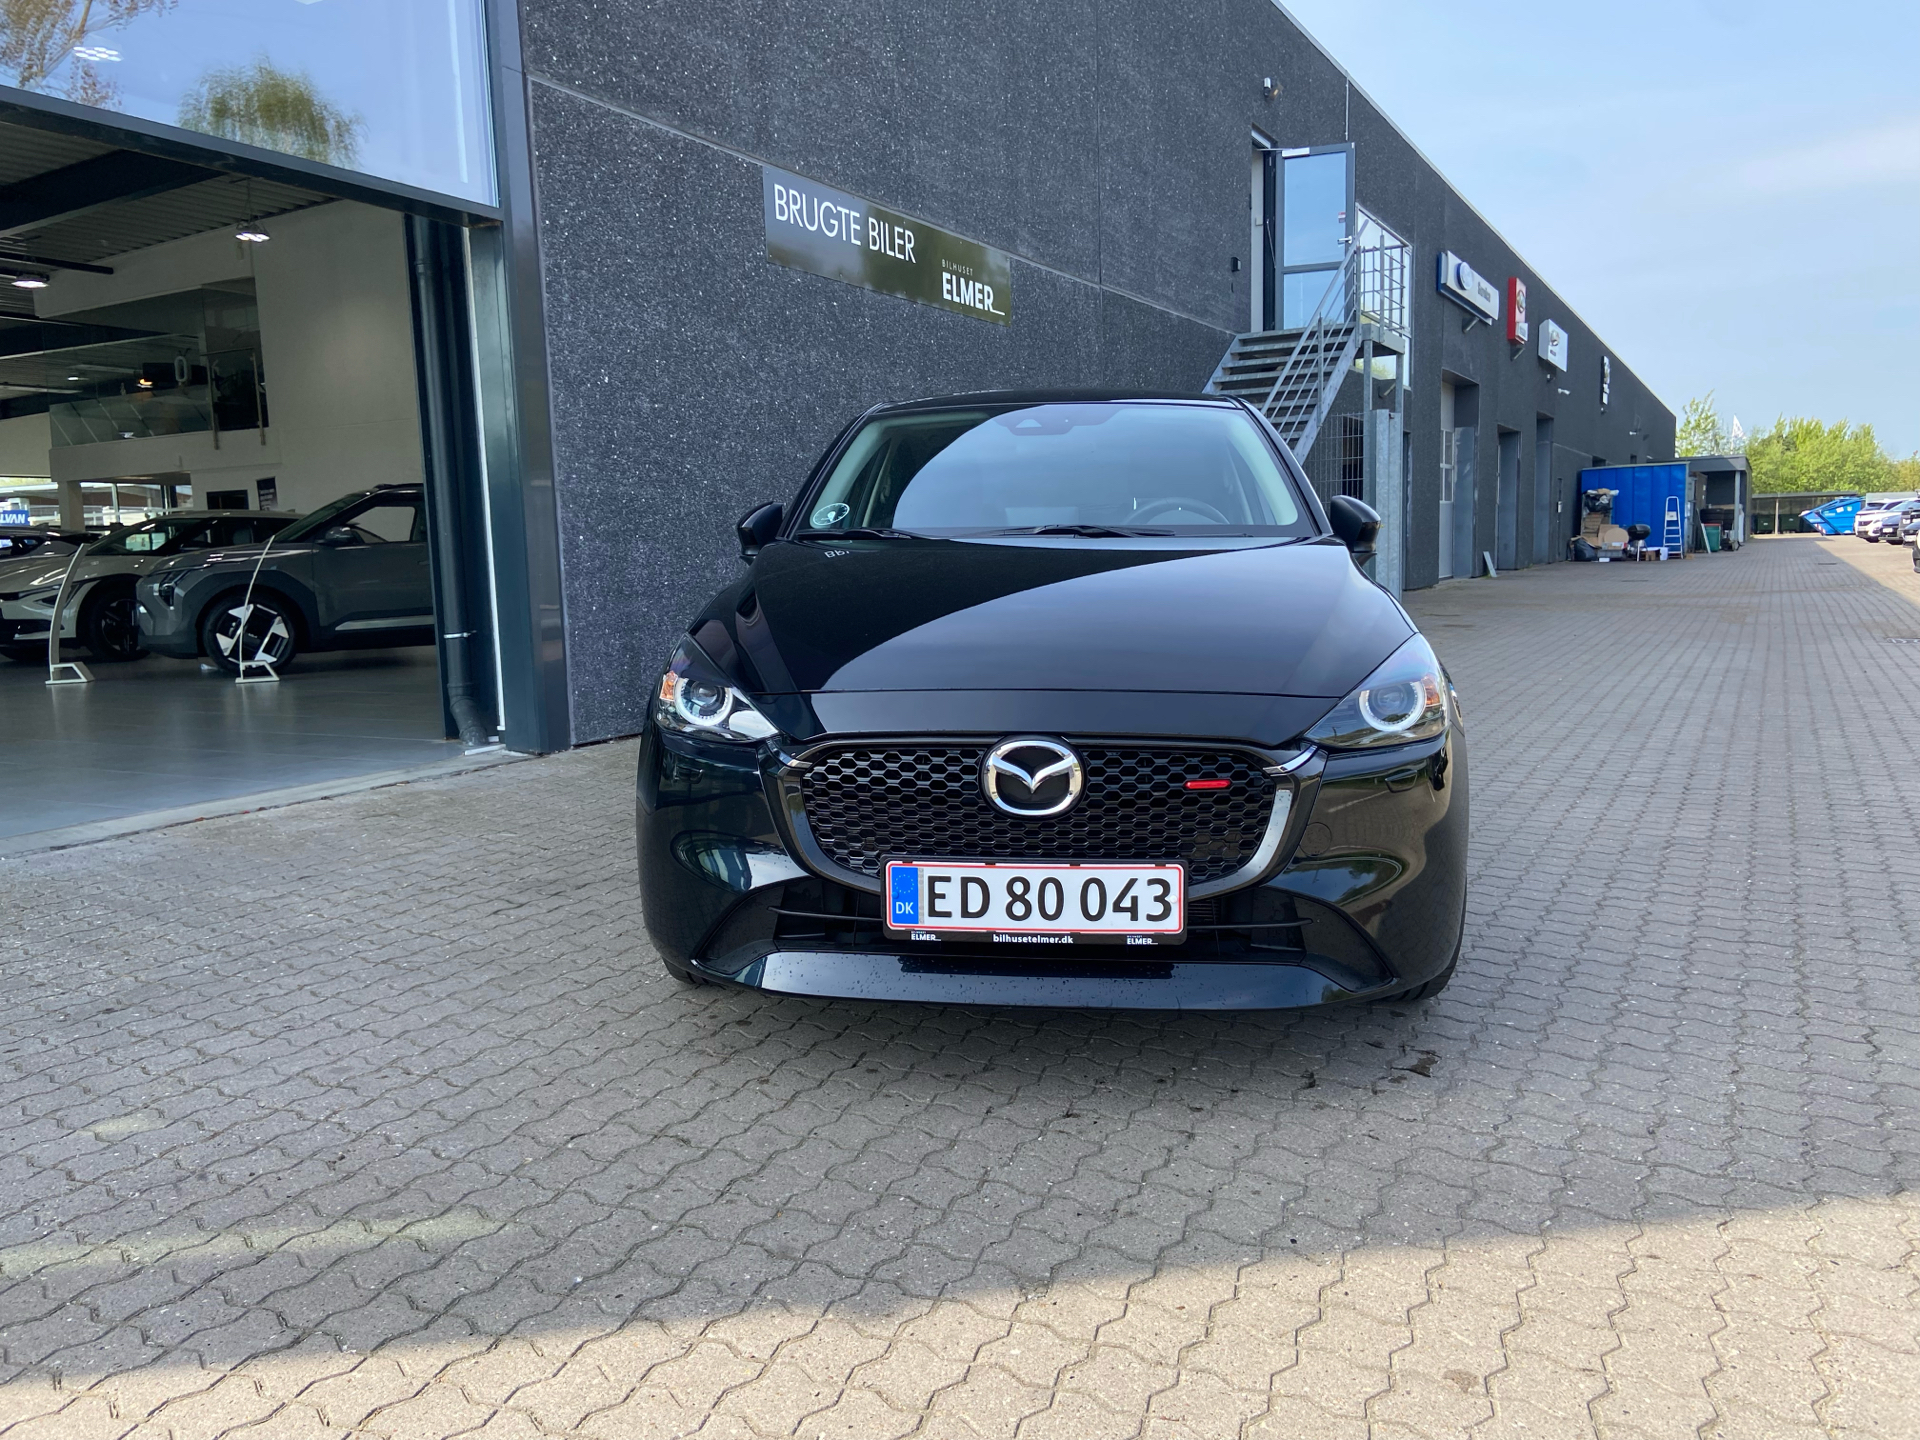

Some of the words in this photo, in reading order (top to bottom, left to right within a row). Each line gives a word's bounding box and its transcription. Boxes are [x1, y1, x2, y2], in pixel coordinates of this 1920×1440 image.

[774, 183, 862, 246] BRUGTE
[868, 216, 917, 264] BILER
[941, 258, 974, 276] BILHUSET
[927, 875, 991, 918] ED
[1005, 876, 1065, 922] 80
[1080, 877, 1172, 922] 043
[895, 901, 914, 915] DK
[993, 934, 1074, 944] bilhusetelmer.dk
